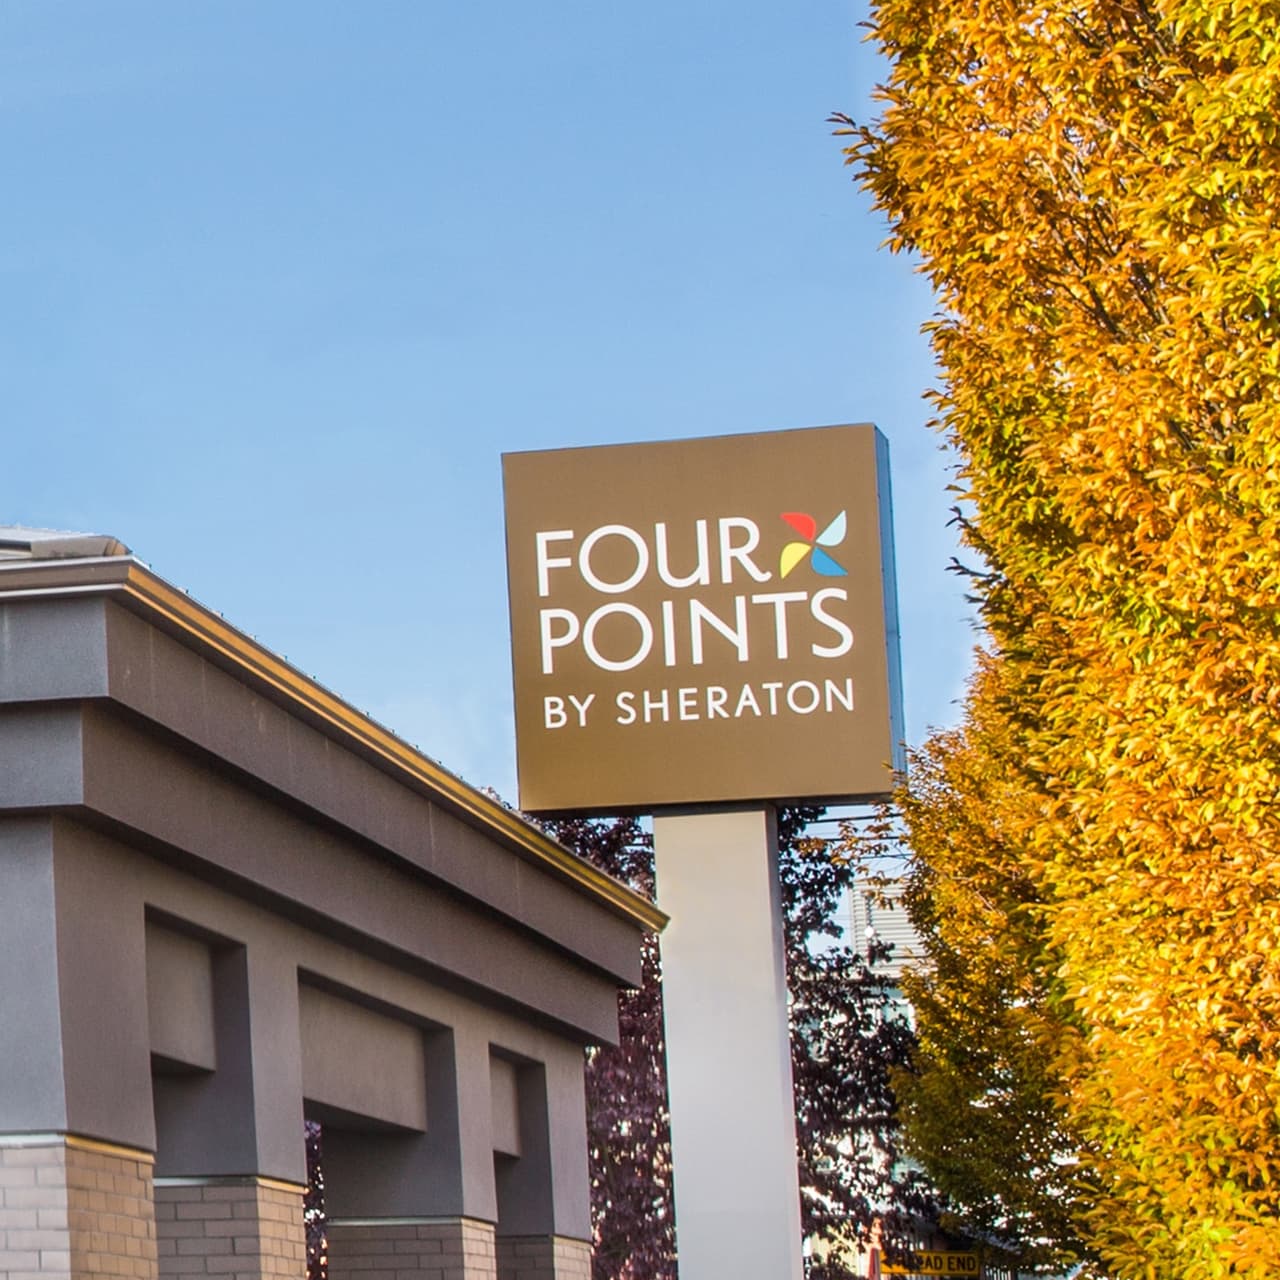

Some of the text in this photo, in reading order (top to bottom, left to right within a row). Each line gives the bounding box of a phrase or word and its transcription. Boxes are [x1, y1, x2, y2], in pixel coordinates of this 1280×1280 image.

[535, 516, 773, 597] FOUR
[540, 587, 854, 674] POINTS
[544, 678, 854, 729] BY SHERATON
[947, 1256, 977, 1271] END
